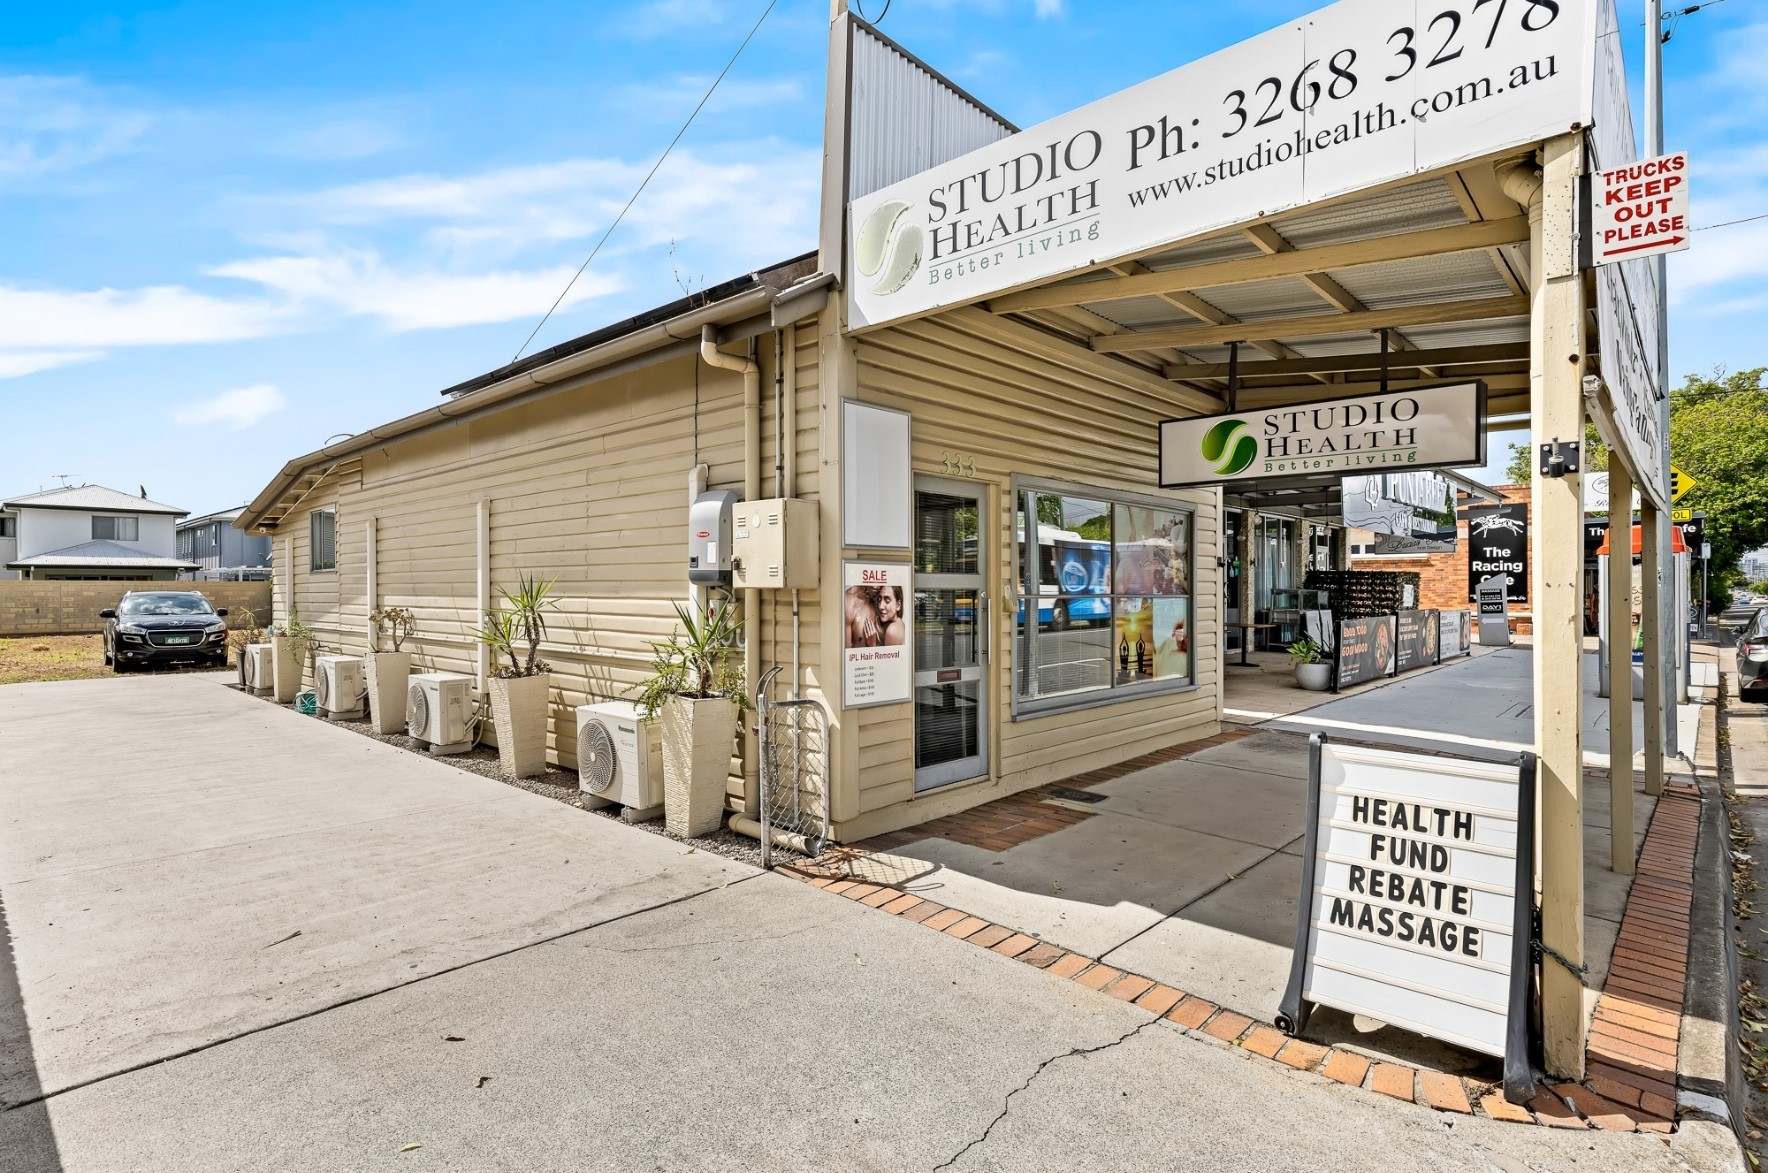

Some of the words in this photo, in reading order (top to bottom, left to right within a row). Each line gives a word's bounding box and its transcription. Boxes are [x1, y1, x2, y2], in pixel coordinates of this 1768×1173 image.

[1126, 115, 1201, 172] Ph:
[1222, 48, 1359, 139] 3268
[1385, 0, 1560, 82] 3278
[1127, 55, 1559, 209] www.studiohealth.com.au
[928, 129, 1102, 225] STUDIO
[1602, 156, 1685, 186] TRUCKS
[1605, 175, 1682, 206] KEEP
[928, 179, 1101, 261] HEALTH
[1614, 197, 1674, 223] OUT
[1604, 215, 1684, 244] PLEASE
[928, 249, 1003, 285] Better
[1017, 219, 1101, 260] living
[1264, 397, 1420, 436] STUDIO
[1264, 427, 1418, 458] HEALTH
[941, 451, 977, 478] 333
[1264, 458, 1334, 473] Better
[1345, 450, 1417, 467] living
[1589, 527, 1606, 536] Th
[1682, 524, 1697, 533] fe
[1472, 560, 1523, 573] Racing
[1483, 547, 1511, 557] The
[862, 569, 887, 582] SALE
[860, 652, 874, 661] Hair
[875, 650, 900, 660] Removal
[1352, 795, 1474, 841] HEALTH
[1371, 834, 1449, 873] FUND
[1349, 865, 1470, 916] REBATE
[1330, 898, 1481, 958] MASSAGE
